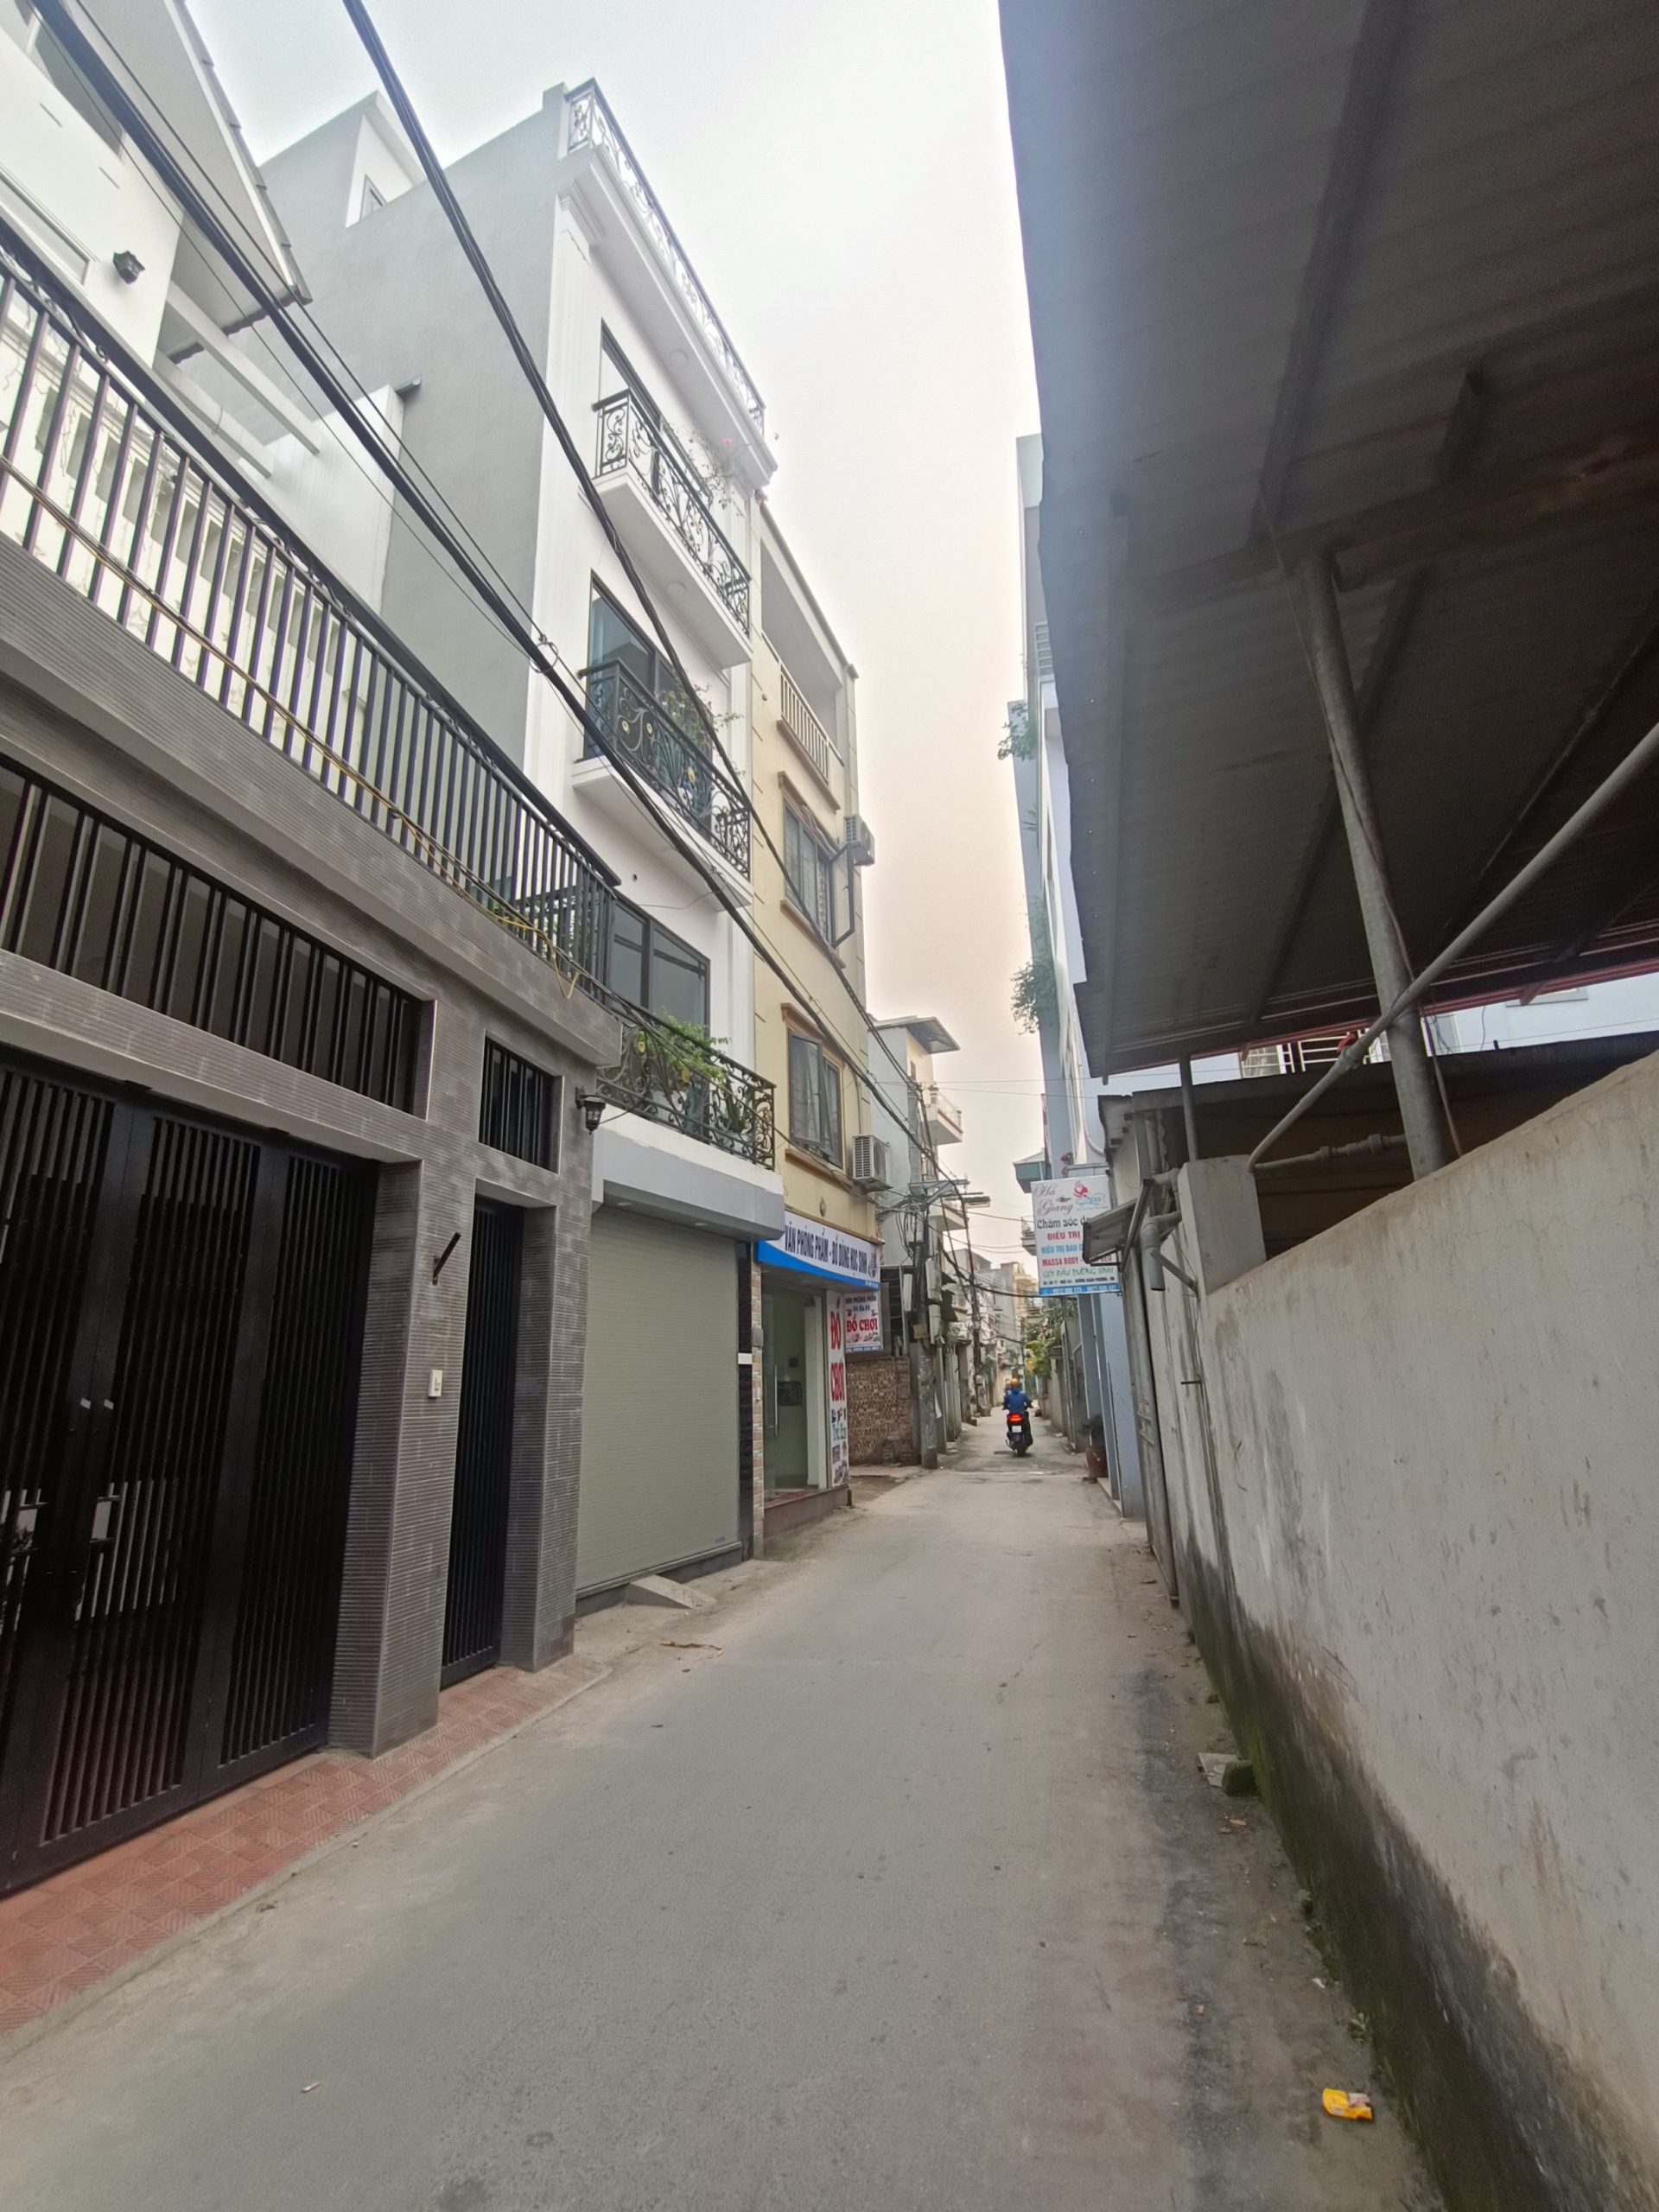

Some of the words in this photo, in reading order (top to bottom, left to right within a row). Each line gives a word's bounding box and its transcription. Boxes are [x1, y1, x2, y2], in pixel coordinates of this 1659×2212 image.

[1038, 1199, 1073, 1216] Giang
[1042, 1258, 1063, 1267] MASSA
[1064, 1256, 1078, 1265] BODY
